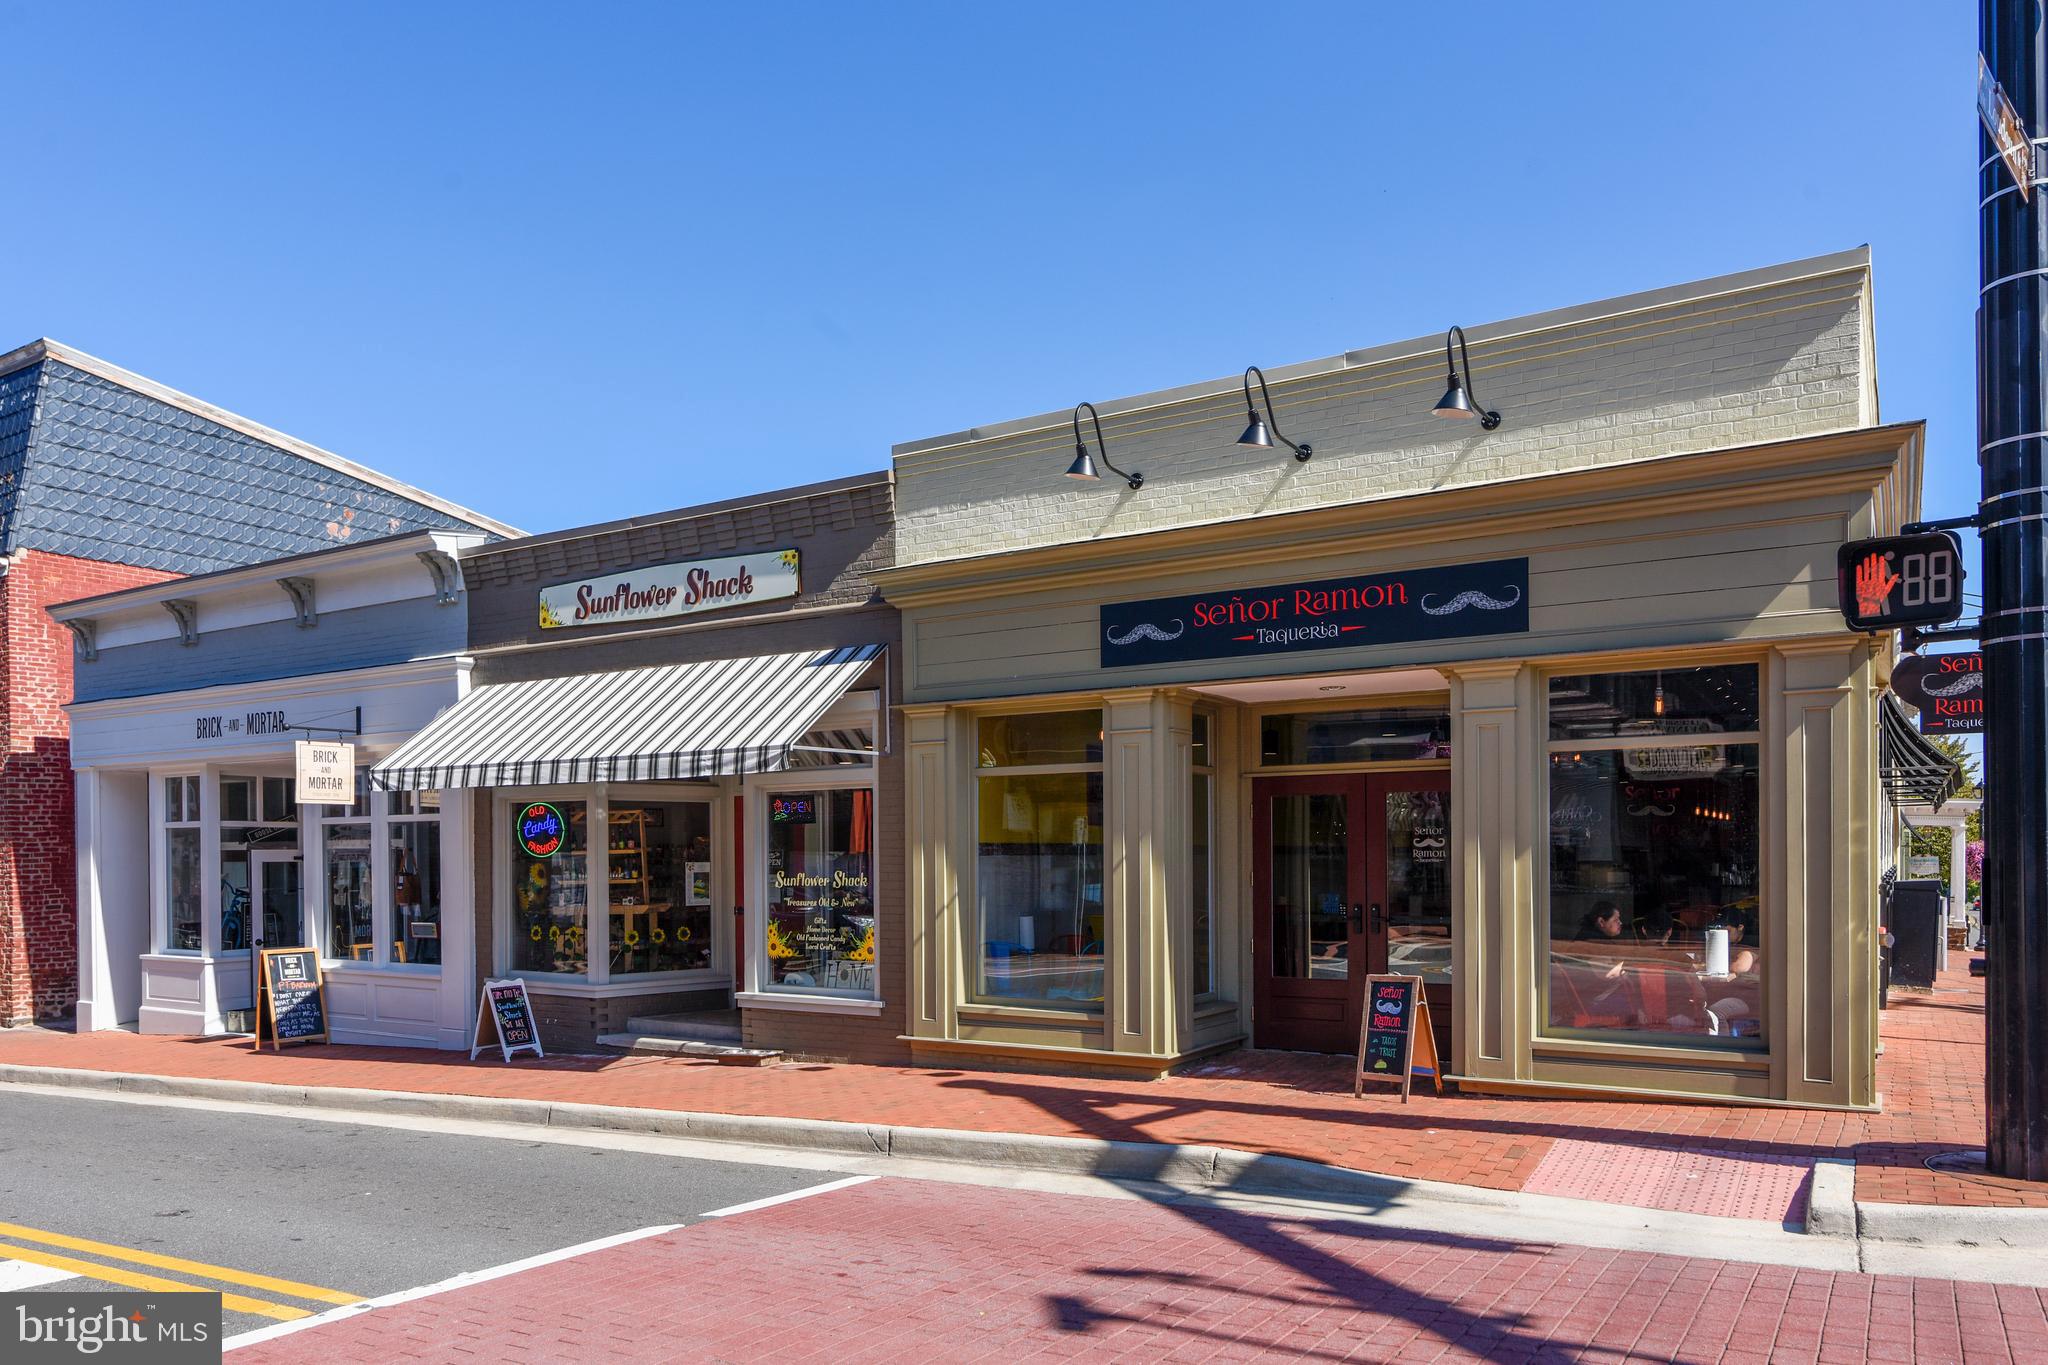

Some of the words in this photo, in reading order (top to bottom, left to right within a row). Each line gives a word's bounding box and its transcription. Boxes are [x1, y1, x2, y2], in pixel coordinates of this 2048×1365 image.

[575, 582, 676, 619] Sunflower
[684, 565, 753, 605] Shack
[1193, 596, 1285, 628] Señor
[1295, 583, 1408, 616] Ramon
[1939, 652, 1983, 673] Señ
[1935, 698, 1983, 715] Ram
[196, 716, 223, 739] BRICK
[246, 710, 285, 735] MORTAR
[313, 750, 338, 764] BRICK
[308, 776, 343, 790] MORTAR
[529, 806, 545, 817] OLD
[782, 801, 812, 814] OPEN
[523, 814, 557, 837] Candy
[1414, 825, 1444, 835] Señor
[527, 837, 558, 854] FASHION
[1413, 849, 1446, 858] Ramon
[775, 871, 829, 888] Sunflower
[833, 870, 868, 888] Shack
[818, 896, 830, 906] Old
[806, 933, 829, 942] Fashioned
[830, 934, 845, 943] Candy
[820, 942, 836, 951] Crafts
[1373, 1013, 1401, 1028] Ramon
[507, 1030, 528, 1041] OPEN
